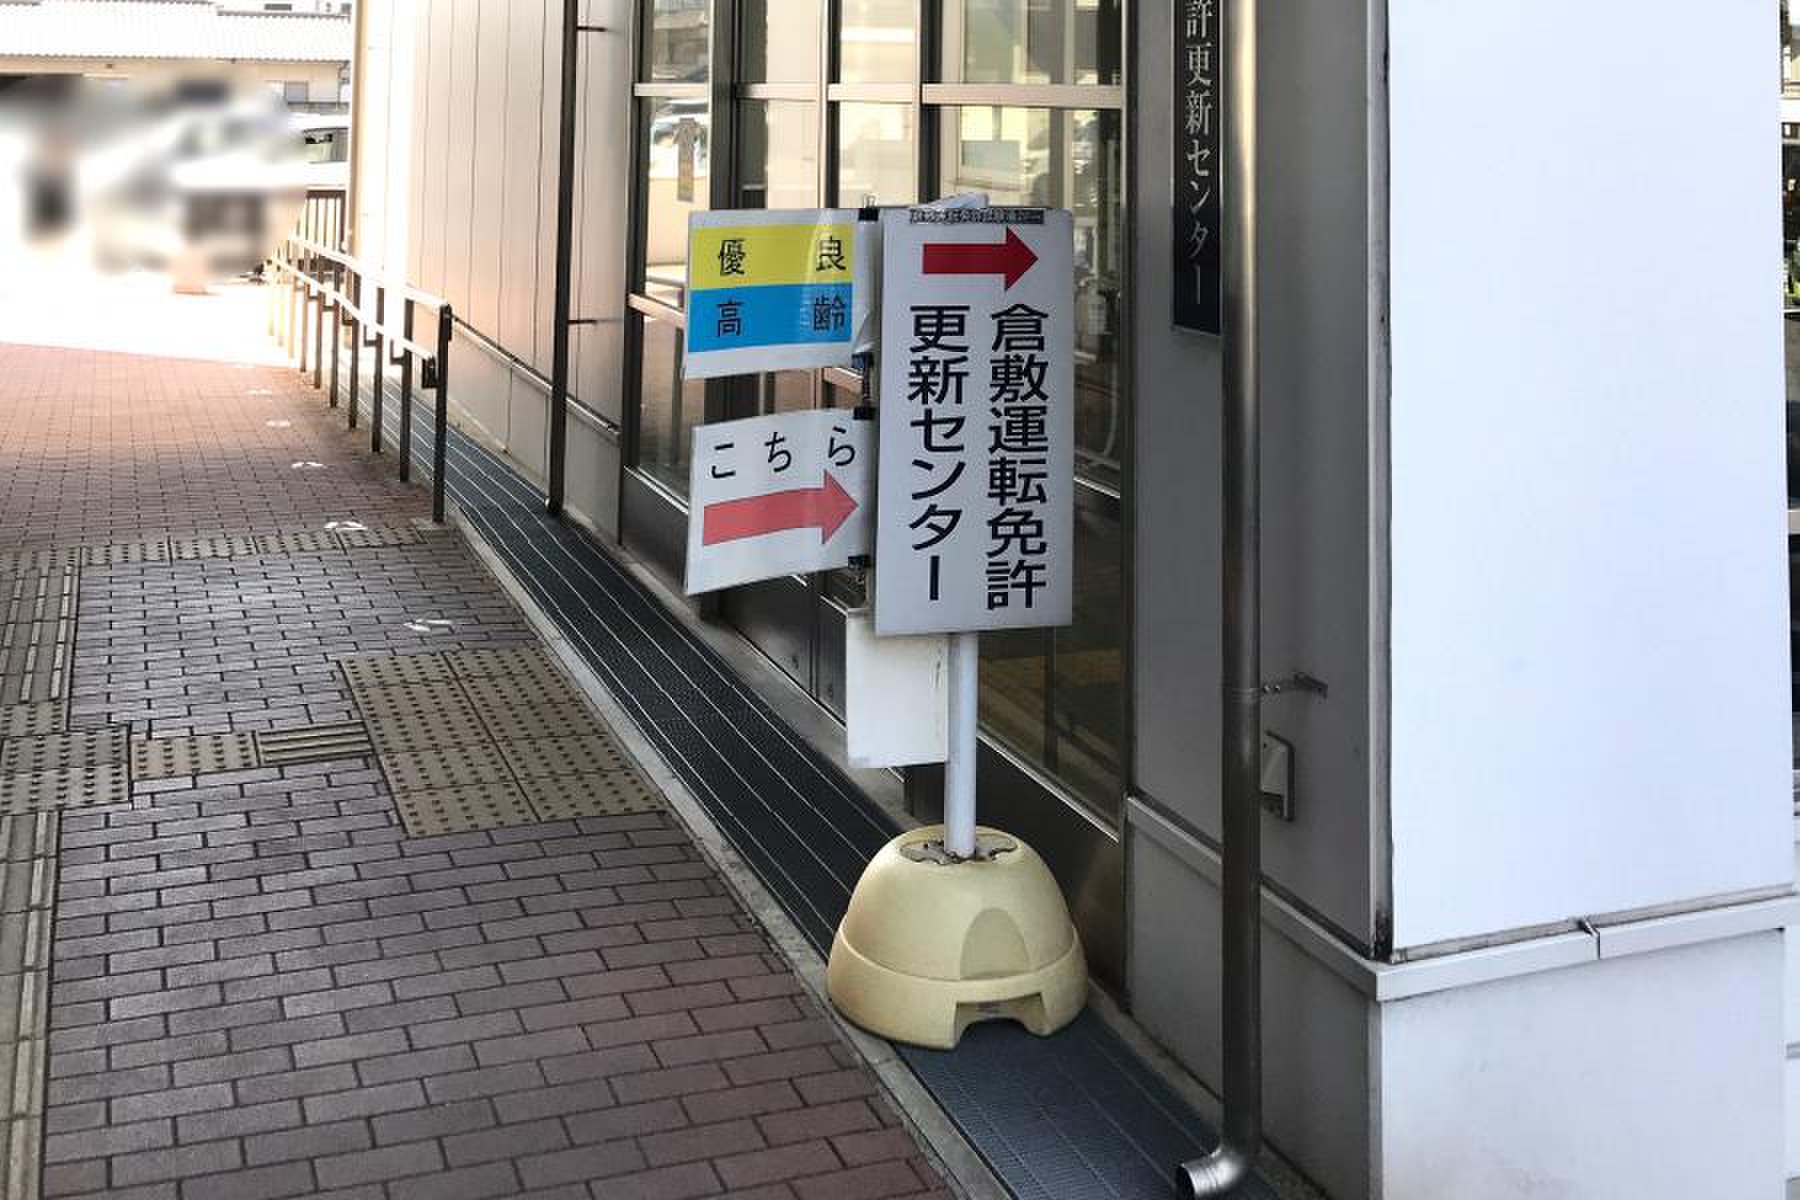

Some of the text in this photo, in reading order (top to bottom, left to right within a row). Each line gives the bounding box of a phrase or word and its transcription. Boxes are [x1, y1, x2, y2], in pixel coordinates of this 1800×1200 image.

[717, 235, 847, 277] 優良
[715, 293, 846, 337] 高齢
[711, 427, 856, 479] こちら
[907, 305, 970, 601] 更新センター
[986, 303, 1049, 610] 倉敷運転免許
